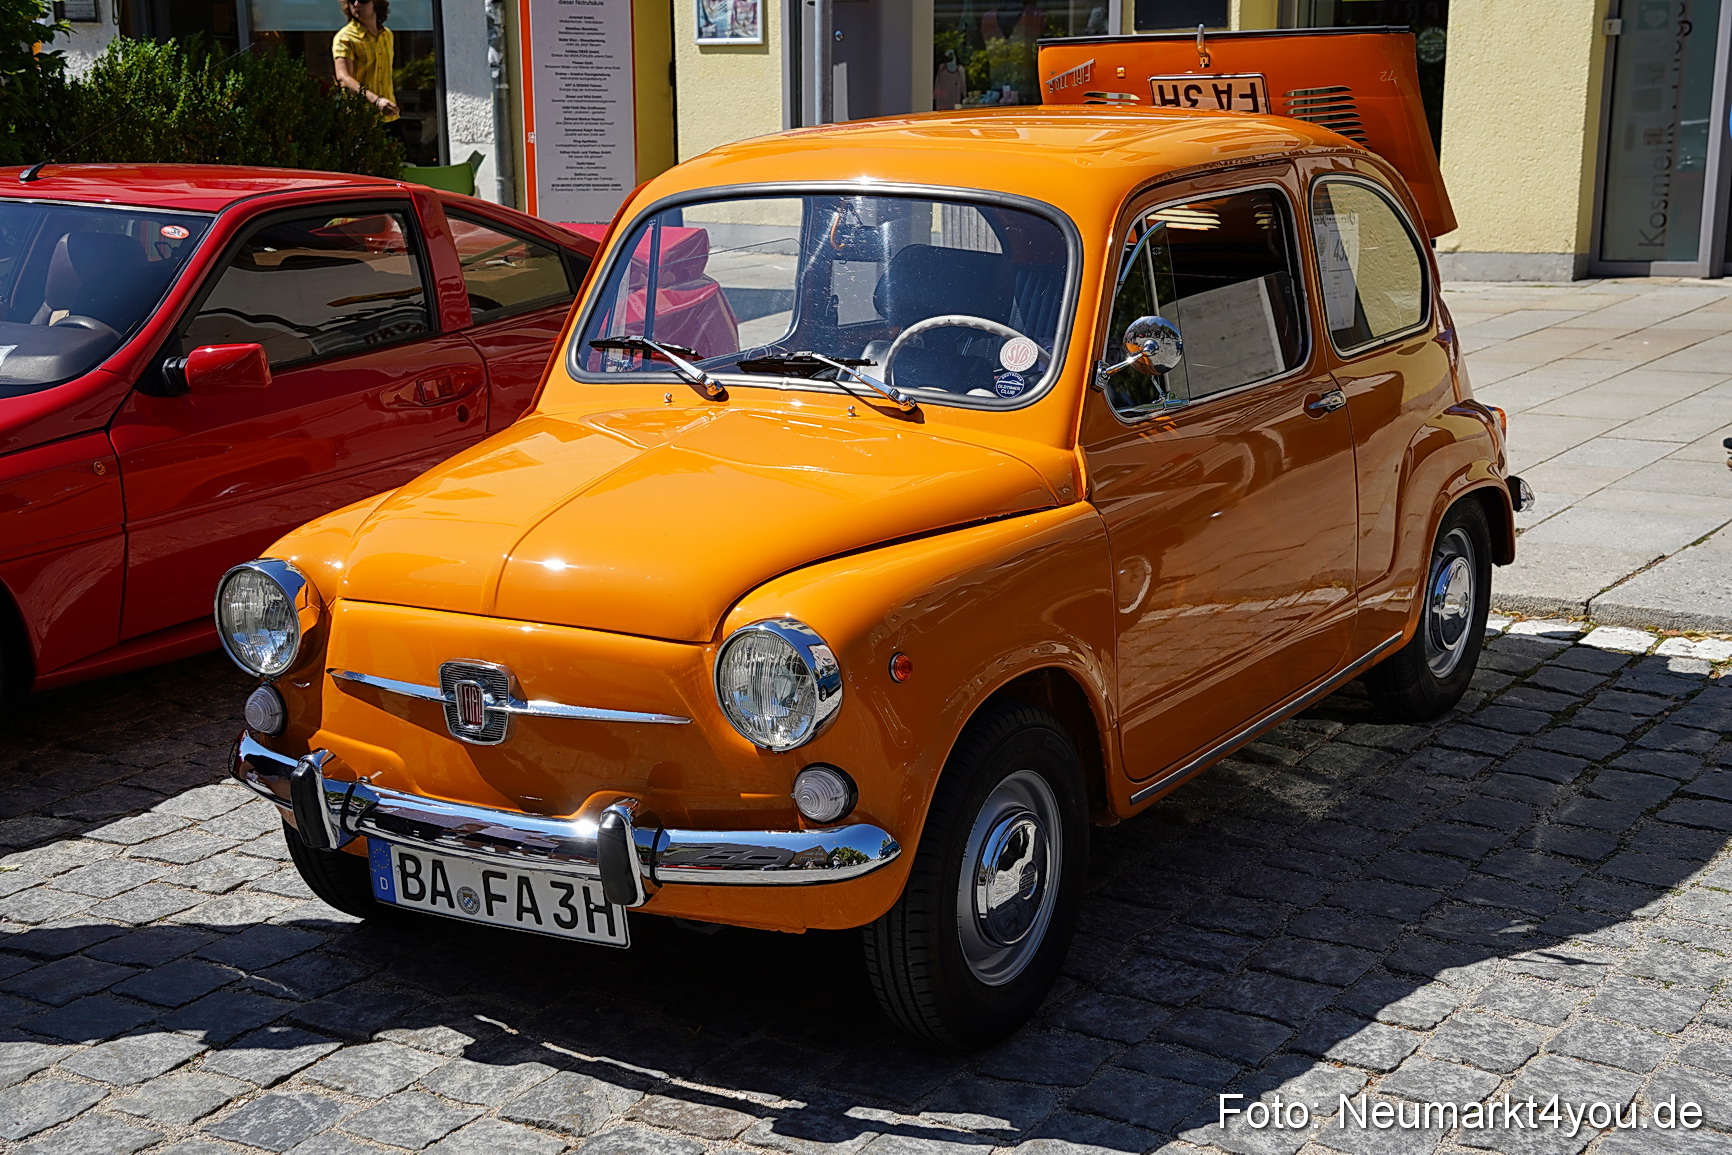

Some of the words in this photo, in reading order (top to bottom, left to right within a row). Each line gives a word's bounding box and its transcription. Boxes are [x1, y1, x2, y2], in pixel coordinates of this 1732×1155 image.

[1072, 63, 1091, 87] FIAT
[464, 686, 482, 723] FIAT
[380, 876, 389, 891] D
[399, 852, 456, 909] BA
